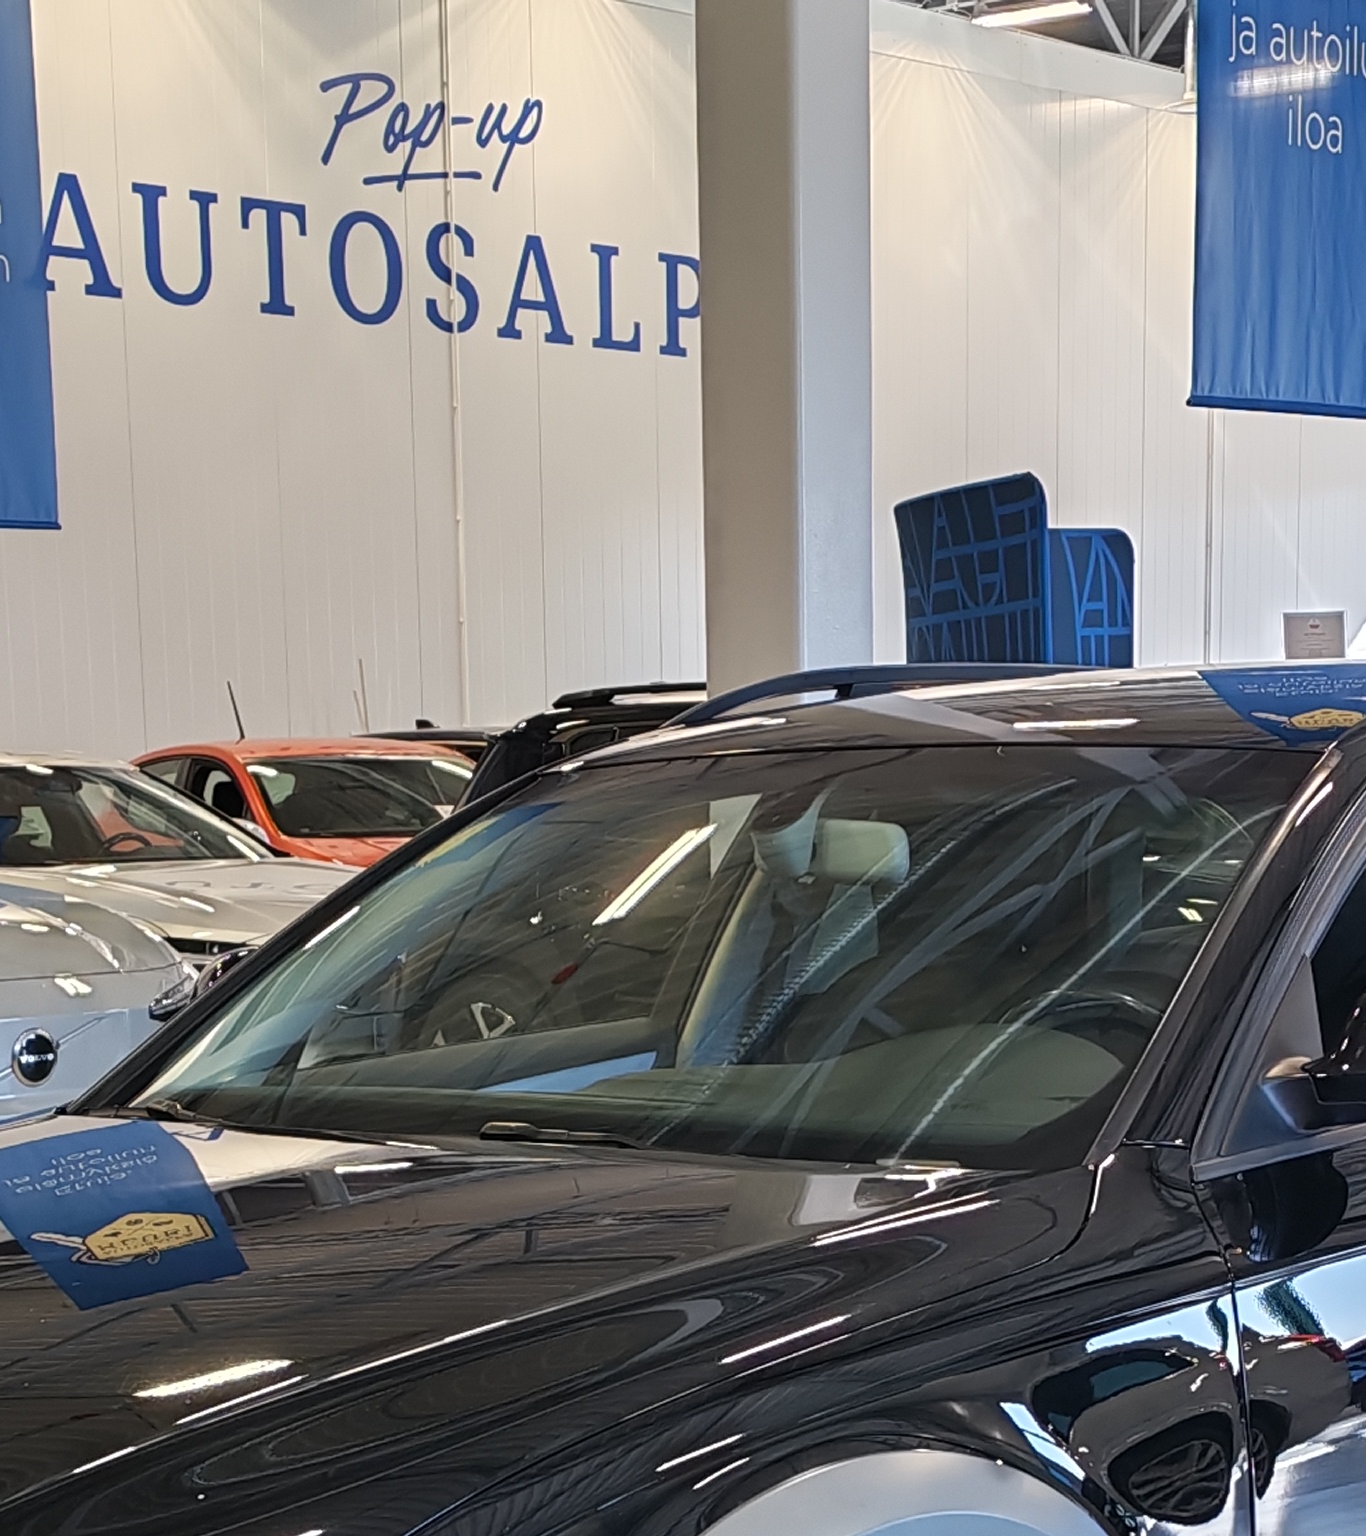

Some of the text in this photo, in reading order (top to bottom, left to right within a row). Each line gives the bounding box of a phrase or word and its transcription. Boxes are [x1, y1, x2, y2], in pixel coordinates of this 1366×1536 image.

[1228, 0, 1257, 63] ja
[319, 72, 543, 192] Pop-up
[1287, 94, 1344, 155] iloa
